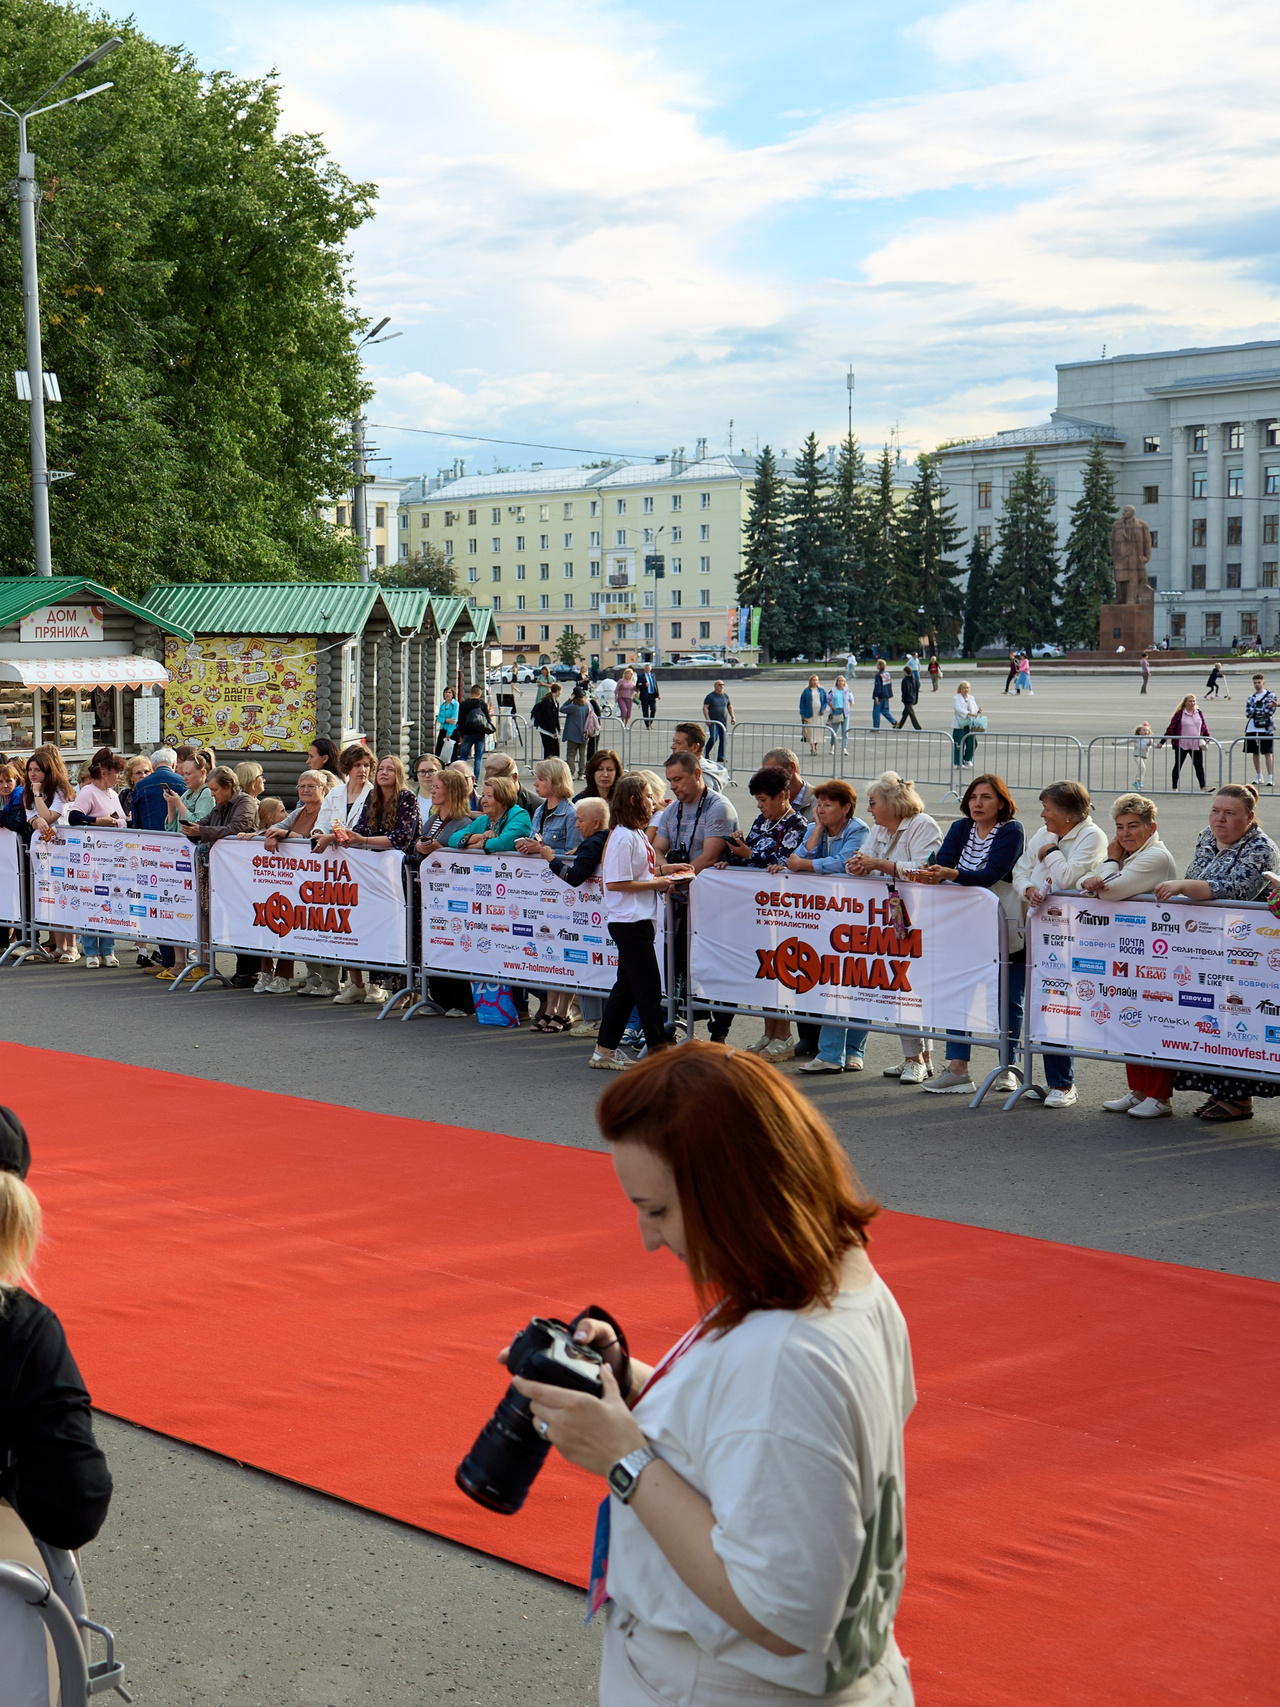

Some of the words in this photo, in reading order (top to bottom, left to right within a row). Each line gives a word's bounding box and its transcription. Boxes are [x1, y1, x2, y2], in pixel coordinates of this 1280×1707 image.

[46, 609, 77, 624] ДОМ
[35, 626, 90, 639] ПРЯНИКА
[252, 855, 322, 873] ФЕСТИВАЛЬ
[324, 859, 352, 882] НА
[253, 869, 277, 878] ТЕАТРА,
[277, 871, 294, 879] КИНО
[495, 871, 513, 879] ВЯТИЧ
[258, 878, 293, 886] ЖУРНАЛИСТИКИ
[299, 880, 358, 906] СЕМИ
[755, 890, 864, 914] ФЕСТИВАЛЬ
[252, 891, 353, 938] ХОЛМАХ
[756, 908, 793, 920] ТЕАТРА,
[795, 911, 821, 921] КИНО
[764, 919, 819, 930] ЖУРНАЛИСТИКИ
[1152, 922, 1180, 934] ВЯТИЧ
[1227, 923, 1252, 935] МОРЕ
[830, 923, 922, 958] СЕМИ
[1051, 934, 1075, 942] COFFEE
[1120, 937, 1145, 947] ПОЧТА
[477, 940, 492, 949] МОРЕ
[1120, 946, 1145, 955] РОССИИ
[503, 961, 575, 977] www.7-holmovfest.ru
[755, 936, 913, 995] ХОЛМАХ
[1173, 973, 1191, 981] ПУЛЬС
[1207, 973, 1234, 982] COFFEE
[1091, 1010, 1111, 1019] ПУЛЬС
[1119, 1010, 1142, 1021] МОРЕ
[1148, 1014, 1190, 1026] УГОЛЬКИ
[1199, 1027, 1220, 1035] РАДИО
[1227, 1031, 1258, 1040] PATRON
[1162, 1039, 1280, 1062] www.7-holmovfest.ru
